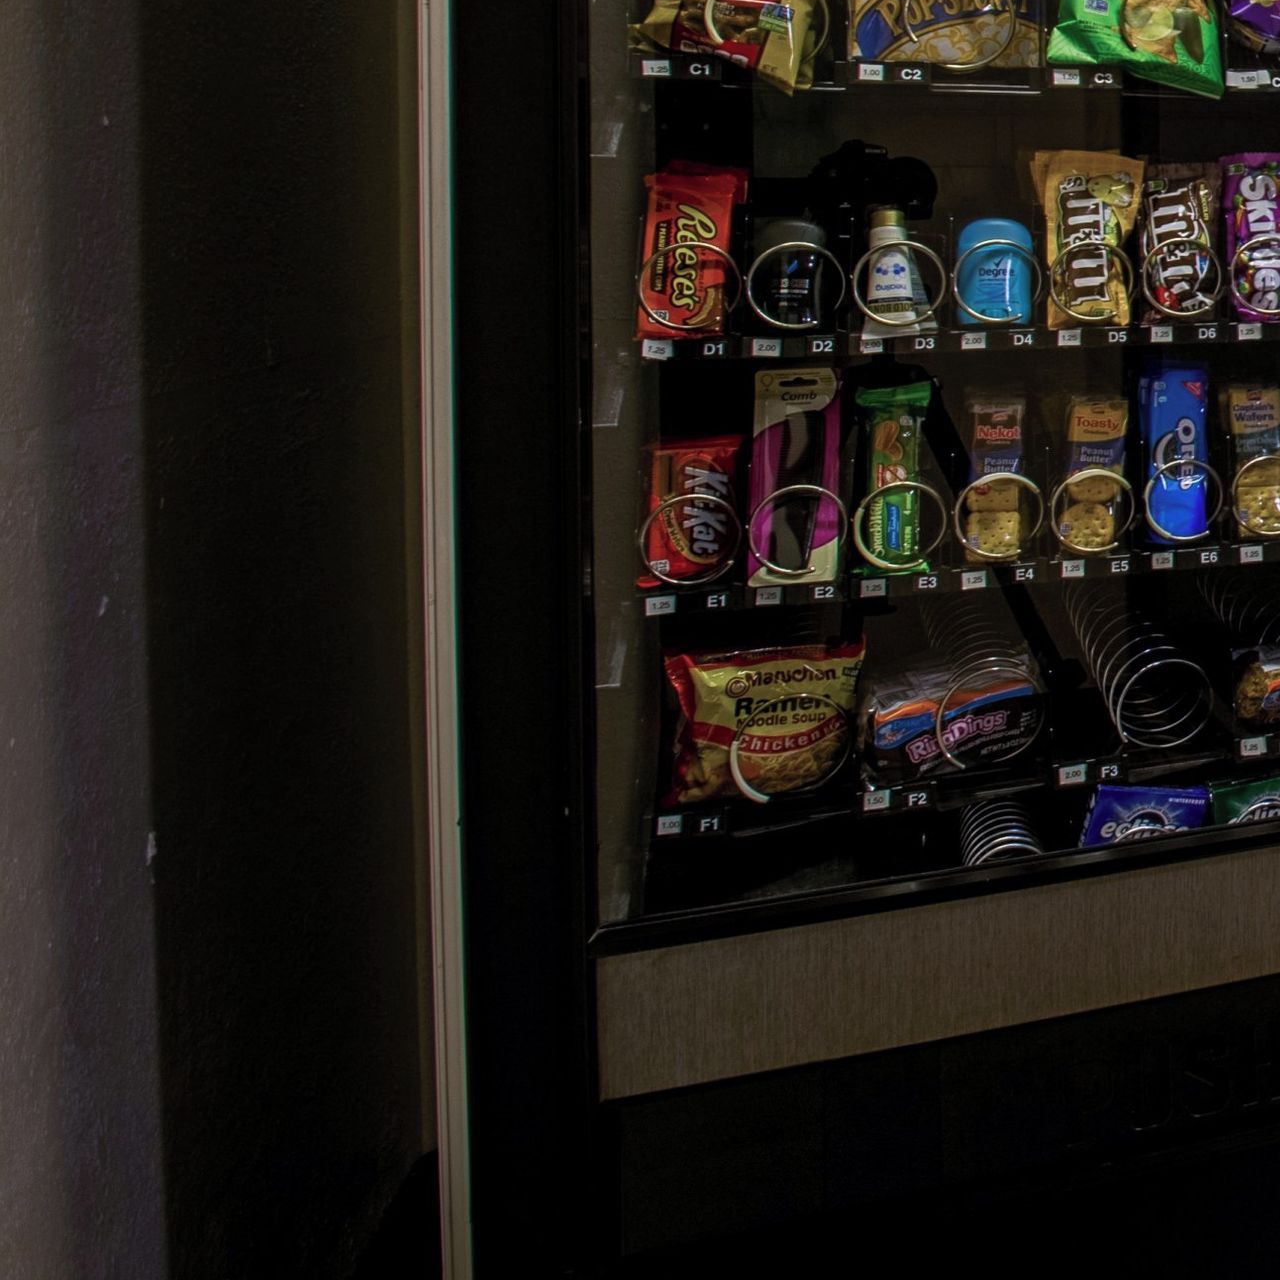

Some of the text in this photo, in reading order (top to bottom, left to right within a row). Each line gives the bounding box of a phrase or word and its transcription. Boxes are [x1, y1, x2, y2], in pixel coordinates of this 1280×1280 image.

[689, 63, 711, 75] C1
[863, 68, 923, 81] 1.00 C2
[1094, 72, 1114, 84] C3
[671, 203, 717, 312] Reese's
[978, 267, 1016, 279] Degree
[1108, 331, 1128, 343] D5
[1198, 327, 1217, 339] D6
[758, 340, 834, 353] 2.00 D2
[915, 337, 936, 350] D3
[1013, 334, 1034, 346] D4
[703, 343, 725, 356] D1
[781, 390, 818, 403] Comb
[1232, 402, 1275, 413] Captain's
[1234, 411, 1275, 422] Wafers
[1074, 415, 1121, 432] Toasty
[976, 425, 1021, 440] Nekot
[1080, 446, 1114, 456] Peanut
[1079, 454, 1110, 464] Butter
[682, 505, 727, 556] Kat
[1201, 551, 1218, 563] E6
[1111, 560, 1130, 572] E5
[1015, 568, 1035, 581] E4
[918, 576, 938, 589] E3
[814, 586, 834, 599] E2
[707, 595, 728, 608] E1
[745, 667, 837, 689] Maruchan
[734, 693, 831, 717] Ramen
[736, 710, 827, 728] Noodle Soup
[949, 709, 1007, 742] Dings
[737, 730, 822, 752] Chicken
[1101, 764, 1119, 779] F3
[866, 792, 928, 806] 1.50 F2
[700, 817, 719, 832] F1
